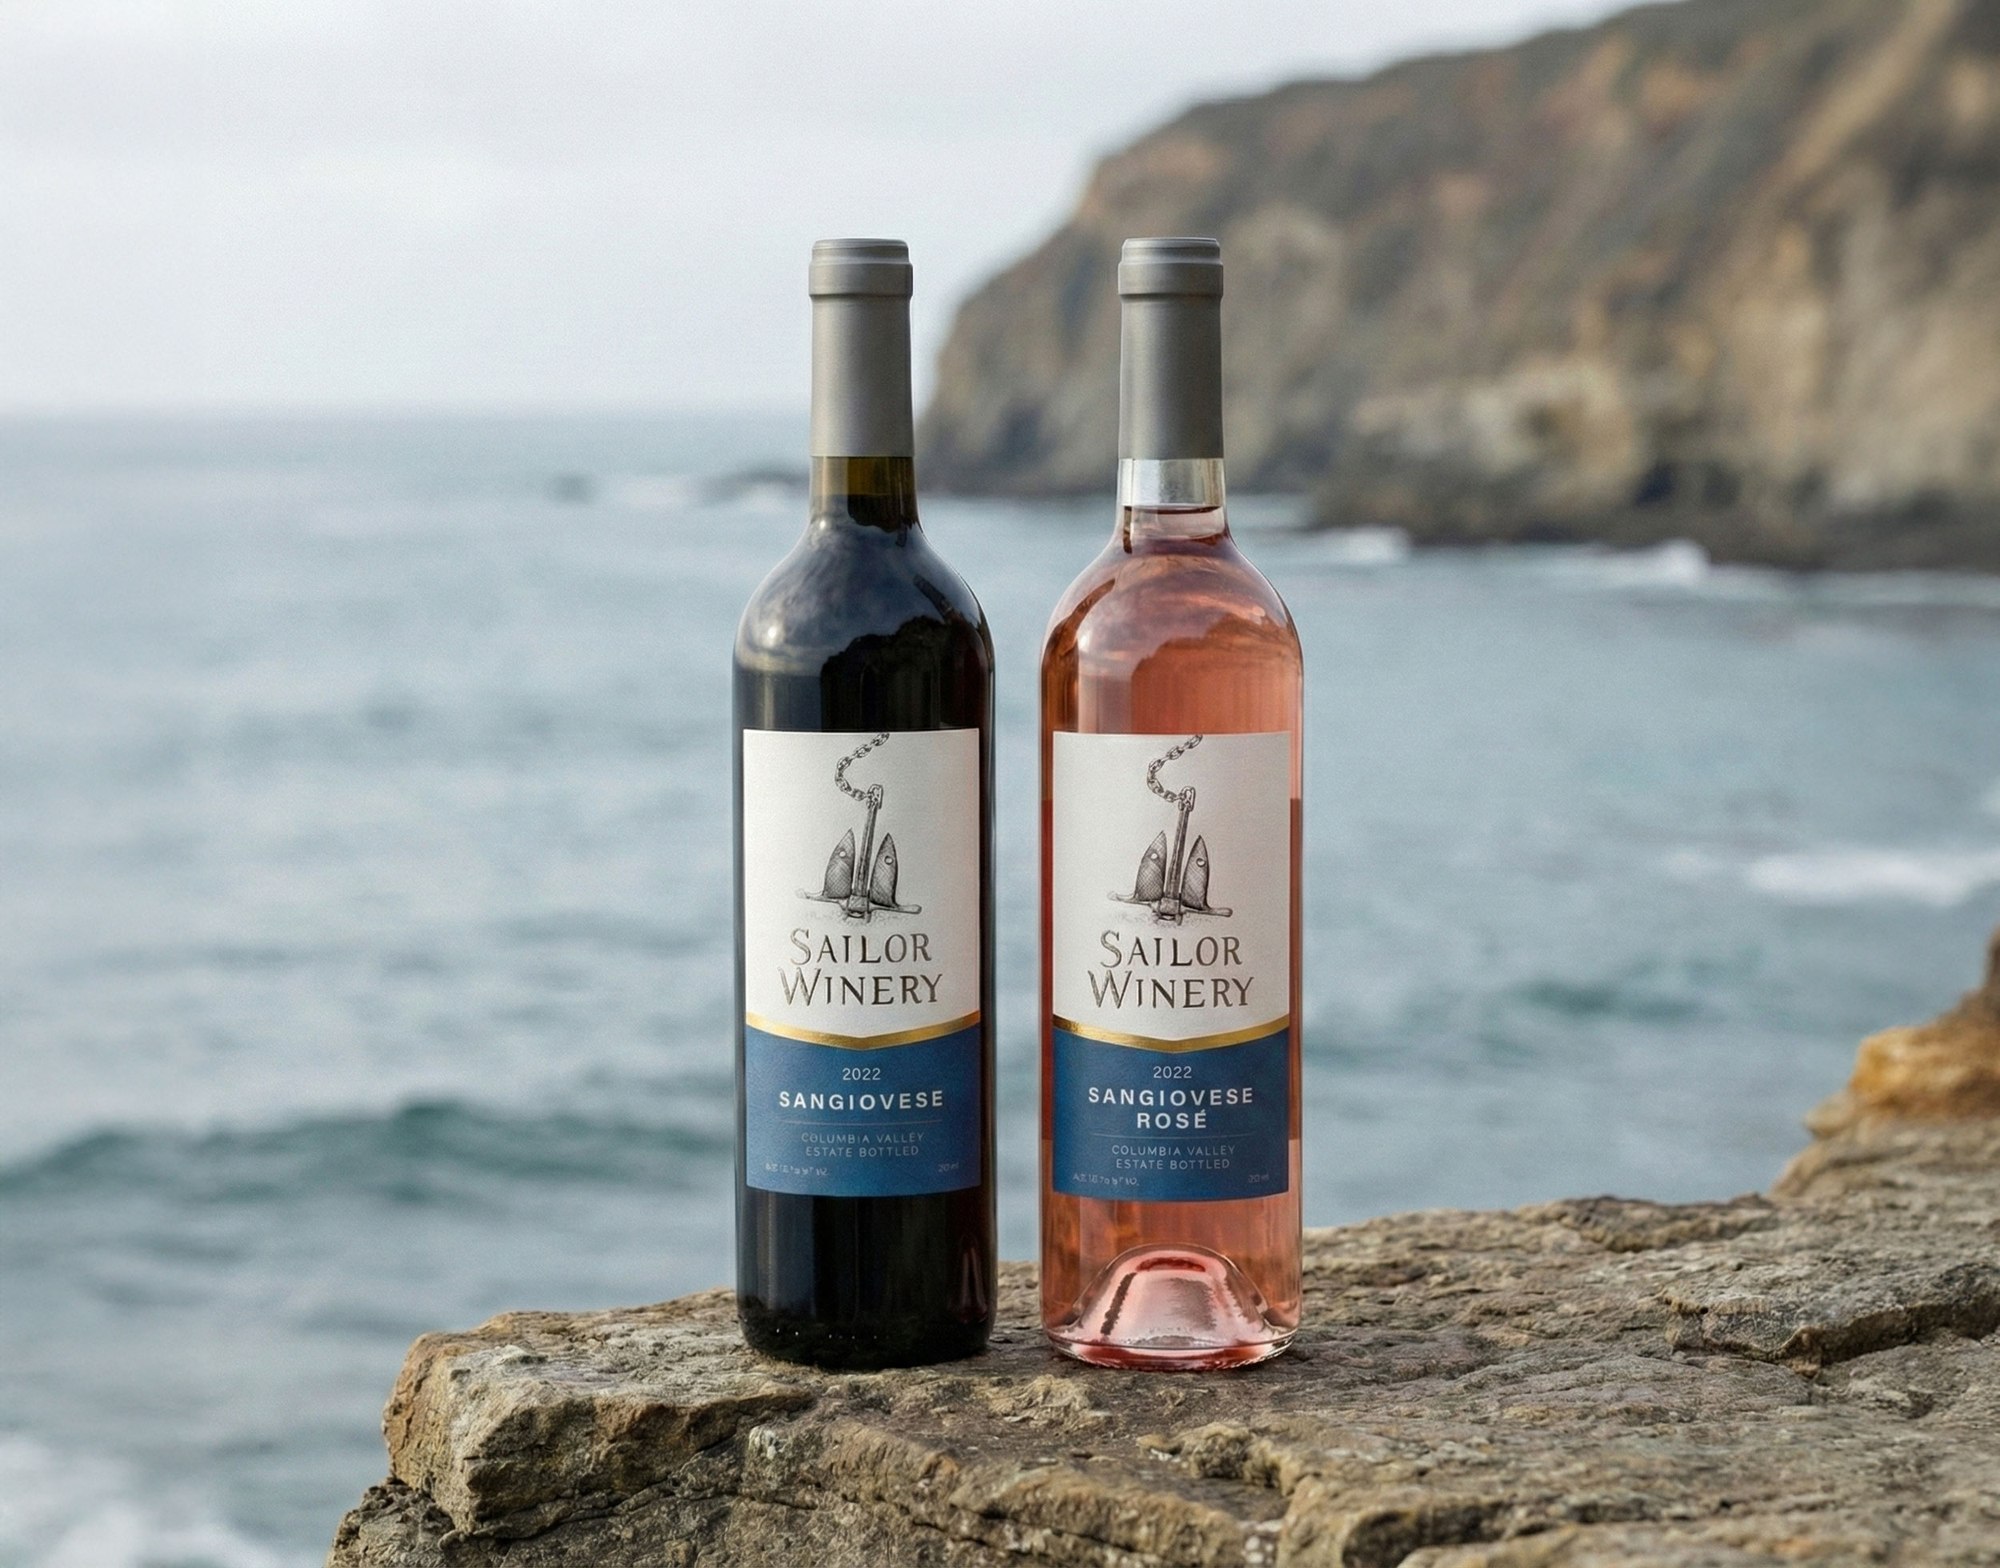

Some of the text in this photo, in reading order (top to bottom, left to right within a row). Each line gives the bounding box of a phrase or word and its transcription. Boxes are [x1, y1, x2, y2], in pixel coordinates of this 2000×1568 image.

[790, 928, 932, 965] SAILOR
[1100, 929, 1242, 968] SAILOR
[777, 967, 943, 1006] WINERY
[1087, 969, 1254, 1009] WINERY
[842, 1067, 881, 1081] 2022
[1153, 1066, 1192, 1079] 2022
[779, 1090, 944, 1111] SANGIOVESE
[1088, 1087, 1253, 1106] SANGIOVESE
[1137, 1108, 1207, 1129] ROSÉ
[801, 1132, 926, 1144] COLUMBIA VALLEY
[805, 1145, 919, 1158] ESTATE BOTTLED
[1111, 1144, 1236, 1156] COLUMBIA VALLEY
[1116, 1158, 1231, 1170] ESTATE BOTTLED
